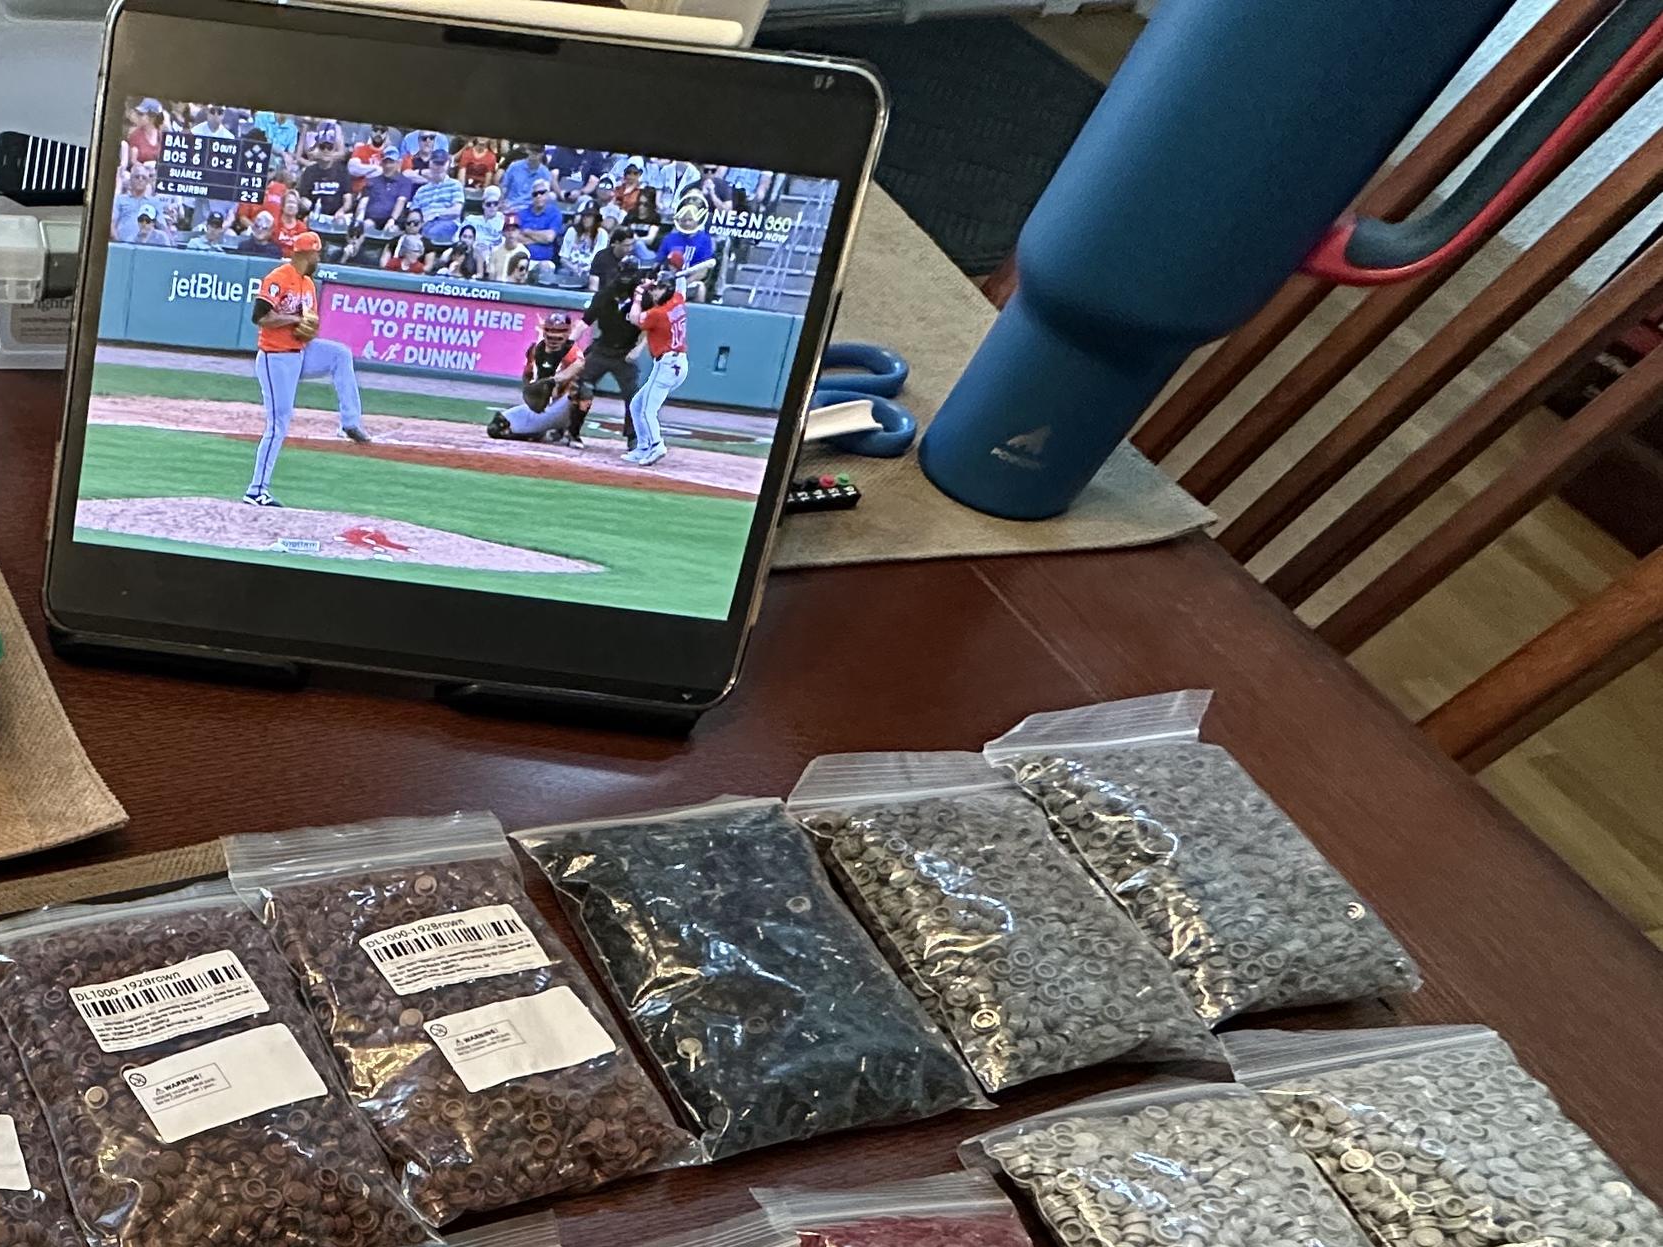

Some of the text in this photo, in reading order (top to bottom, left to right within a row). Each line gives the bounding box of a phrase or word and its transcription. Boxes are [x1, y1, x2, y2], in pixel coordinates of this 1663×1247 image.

[165, 134, 203, 150] BAL 5
[220, 145, 237, 155] OUTS
[163, 150, 201, 165] BOS 6
[177, 183, 208, 195] DURBIN
[711, 208, 792, 233] NESN 360
[709, 226, 789, 243] DOWNLOAD NOW
[168, 270, 243, 302] jetBlue
[421, 281, 501, 300] redsox.com
[331, 293, 409, 317] FLAVOR
[412, 303, 470, 325] FROM
[474, 308, 526, 332] HERE
[371, 319, 484, 348] TO FENWAY
[404, 346, 482, 371] DUNKIN'
[366, 918, 466, 948] DL1000-192Brown
[75, 970, 181, 1002] DL1000-192Brown
